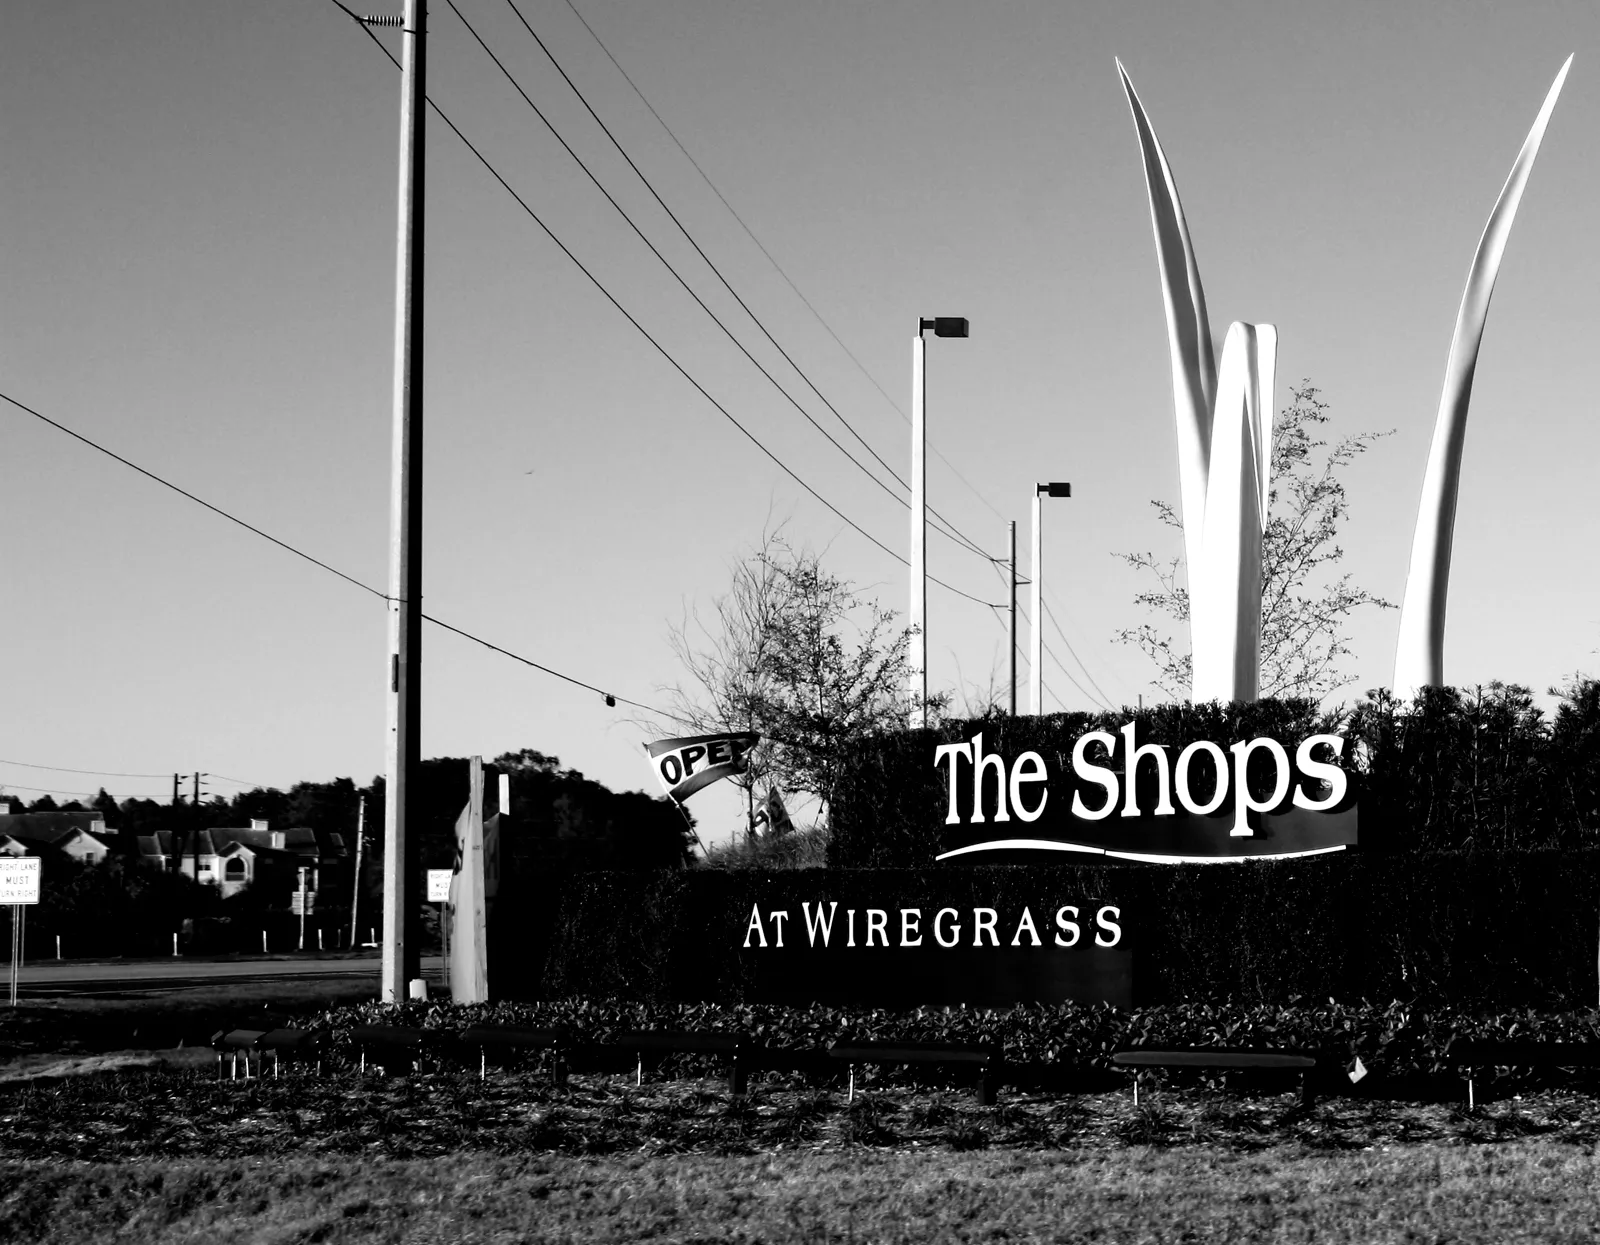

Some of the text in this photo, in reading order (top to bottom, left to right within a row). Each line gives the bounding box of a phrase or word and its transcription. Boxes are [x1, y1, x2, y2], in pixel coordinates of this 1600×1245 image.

[934, 720, 1349, 837] The Shops
[6, 876, 29, 885] MUST
[744, 902, 1122, 948] AT WIREGRASS
